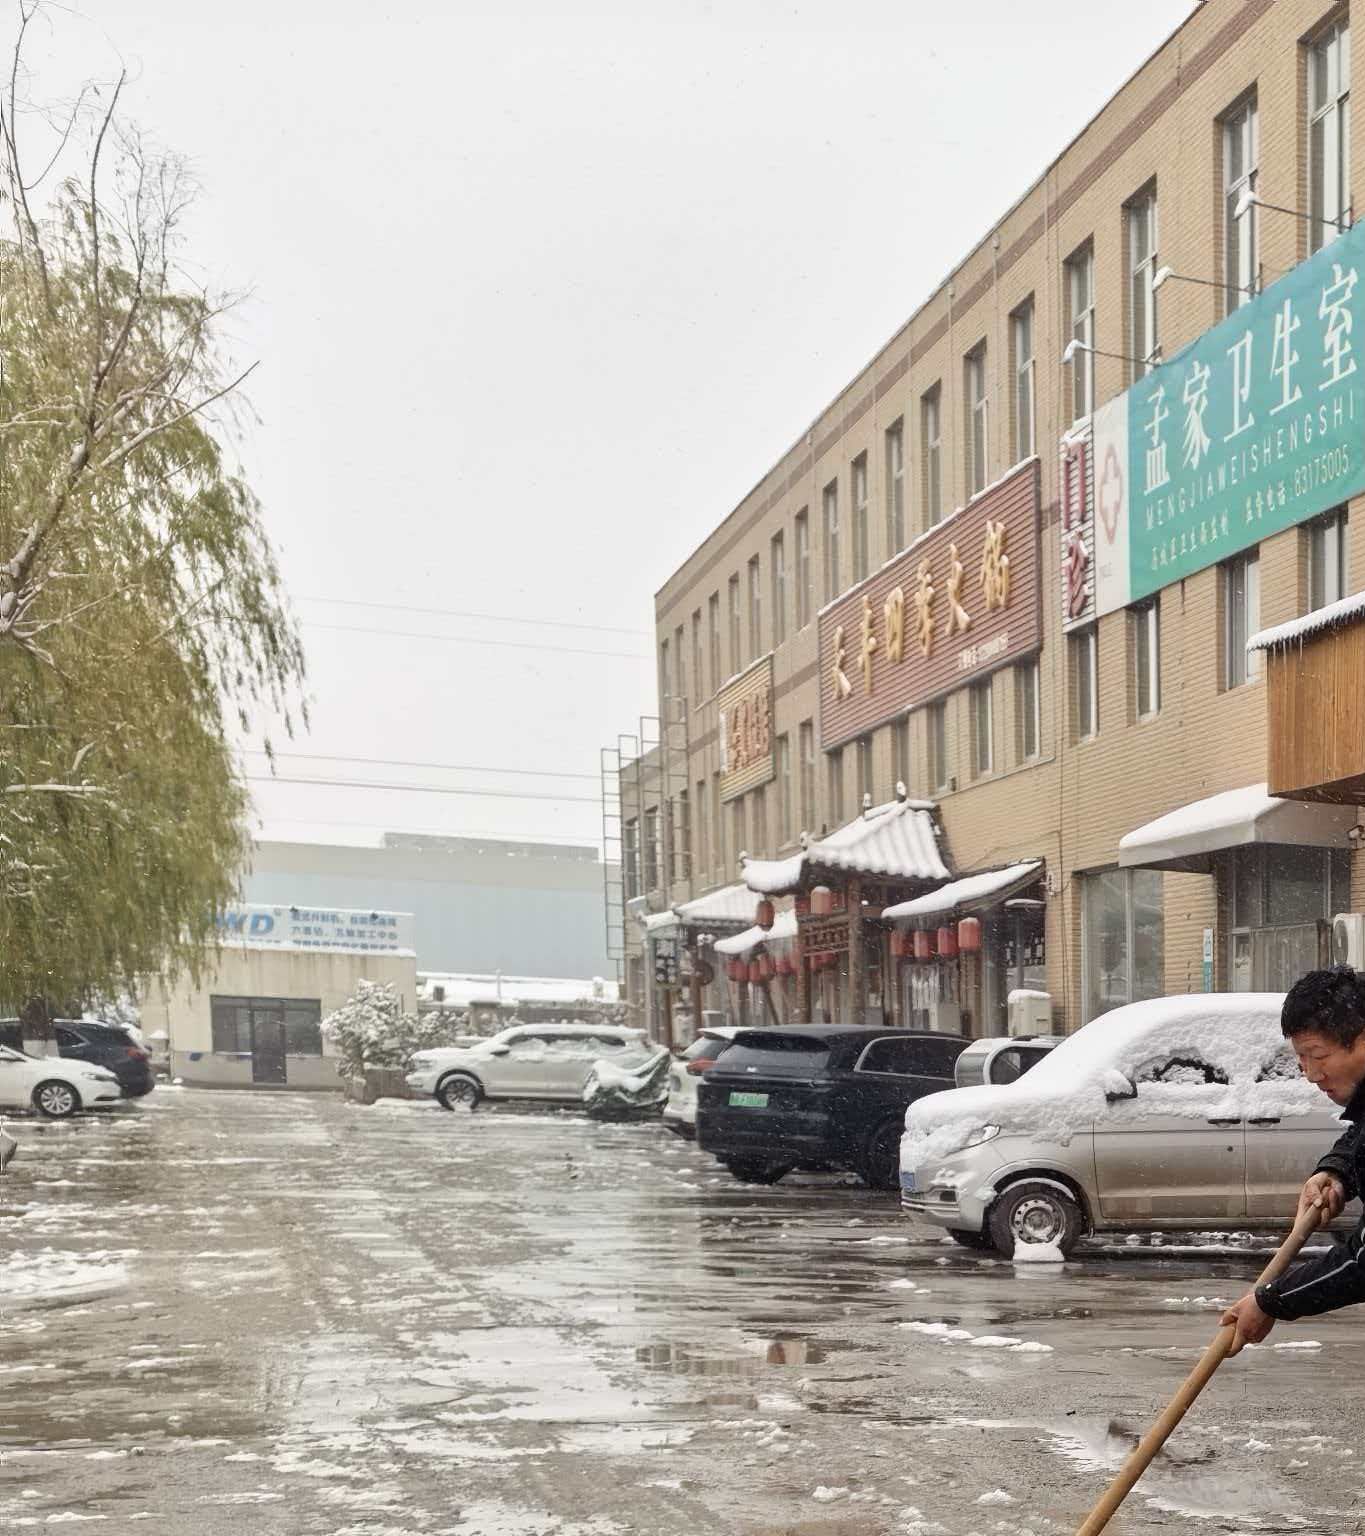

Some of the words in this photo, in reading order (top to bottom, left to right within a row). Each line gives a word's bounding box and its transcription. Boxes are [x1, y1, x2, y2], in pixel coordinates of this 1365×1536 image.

[1143, 263, 1360, 496] 孟家卫生室
